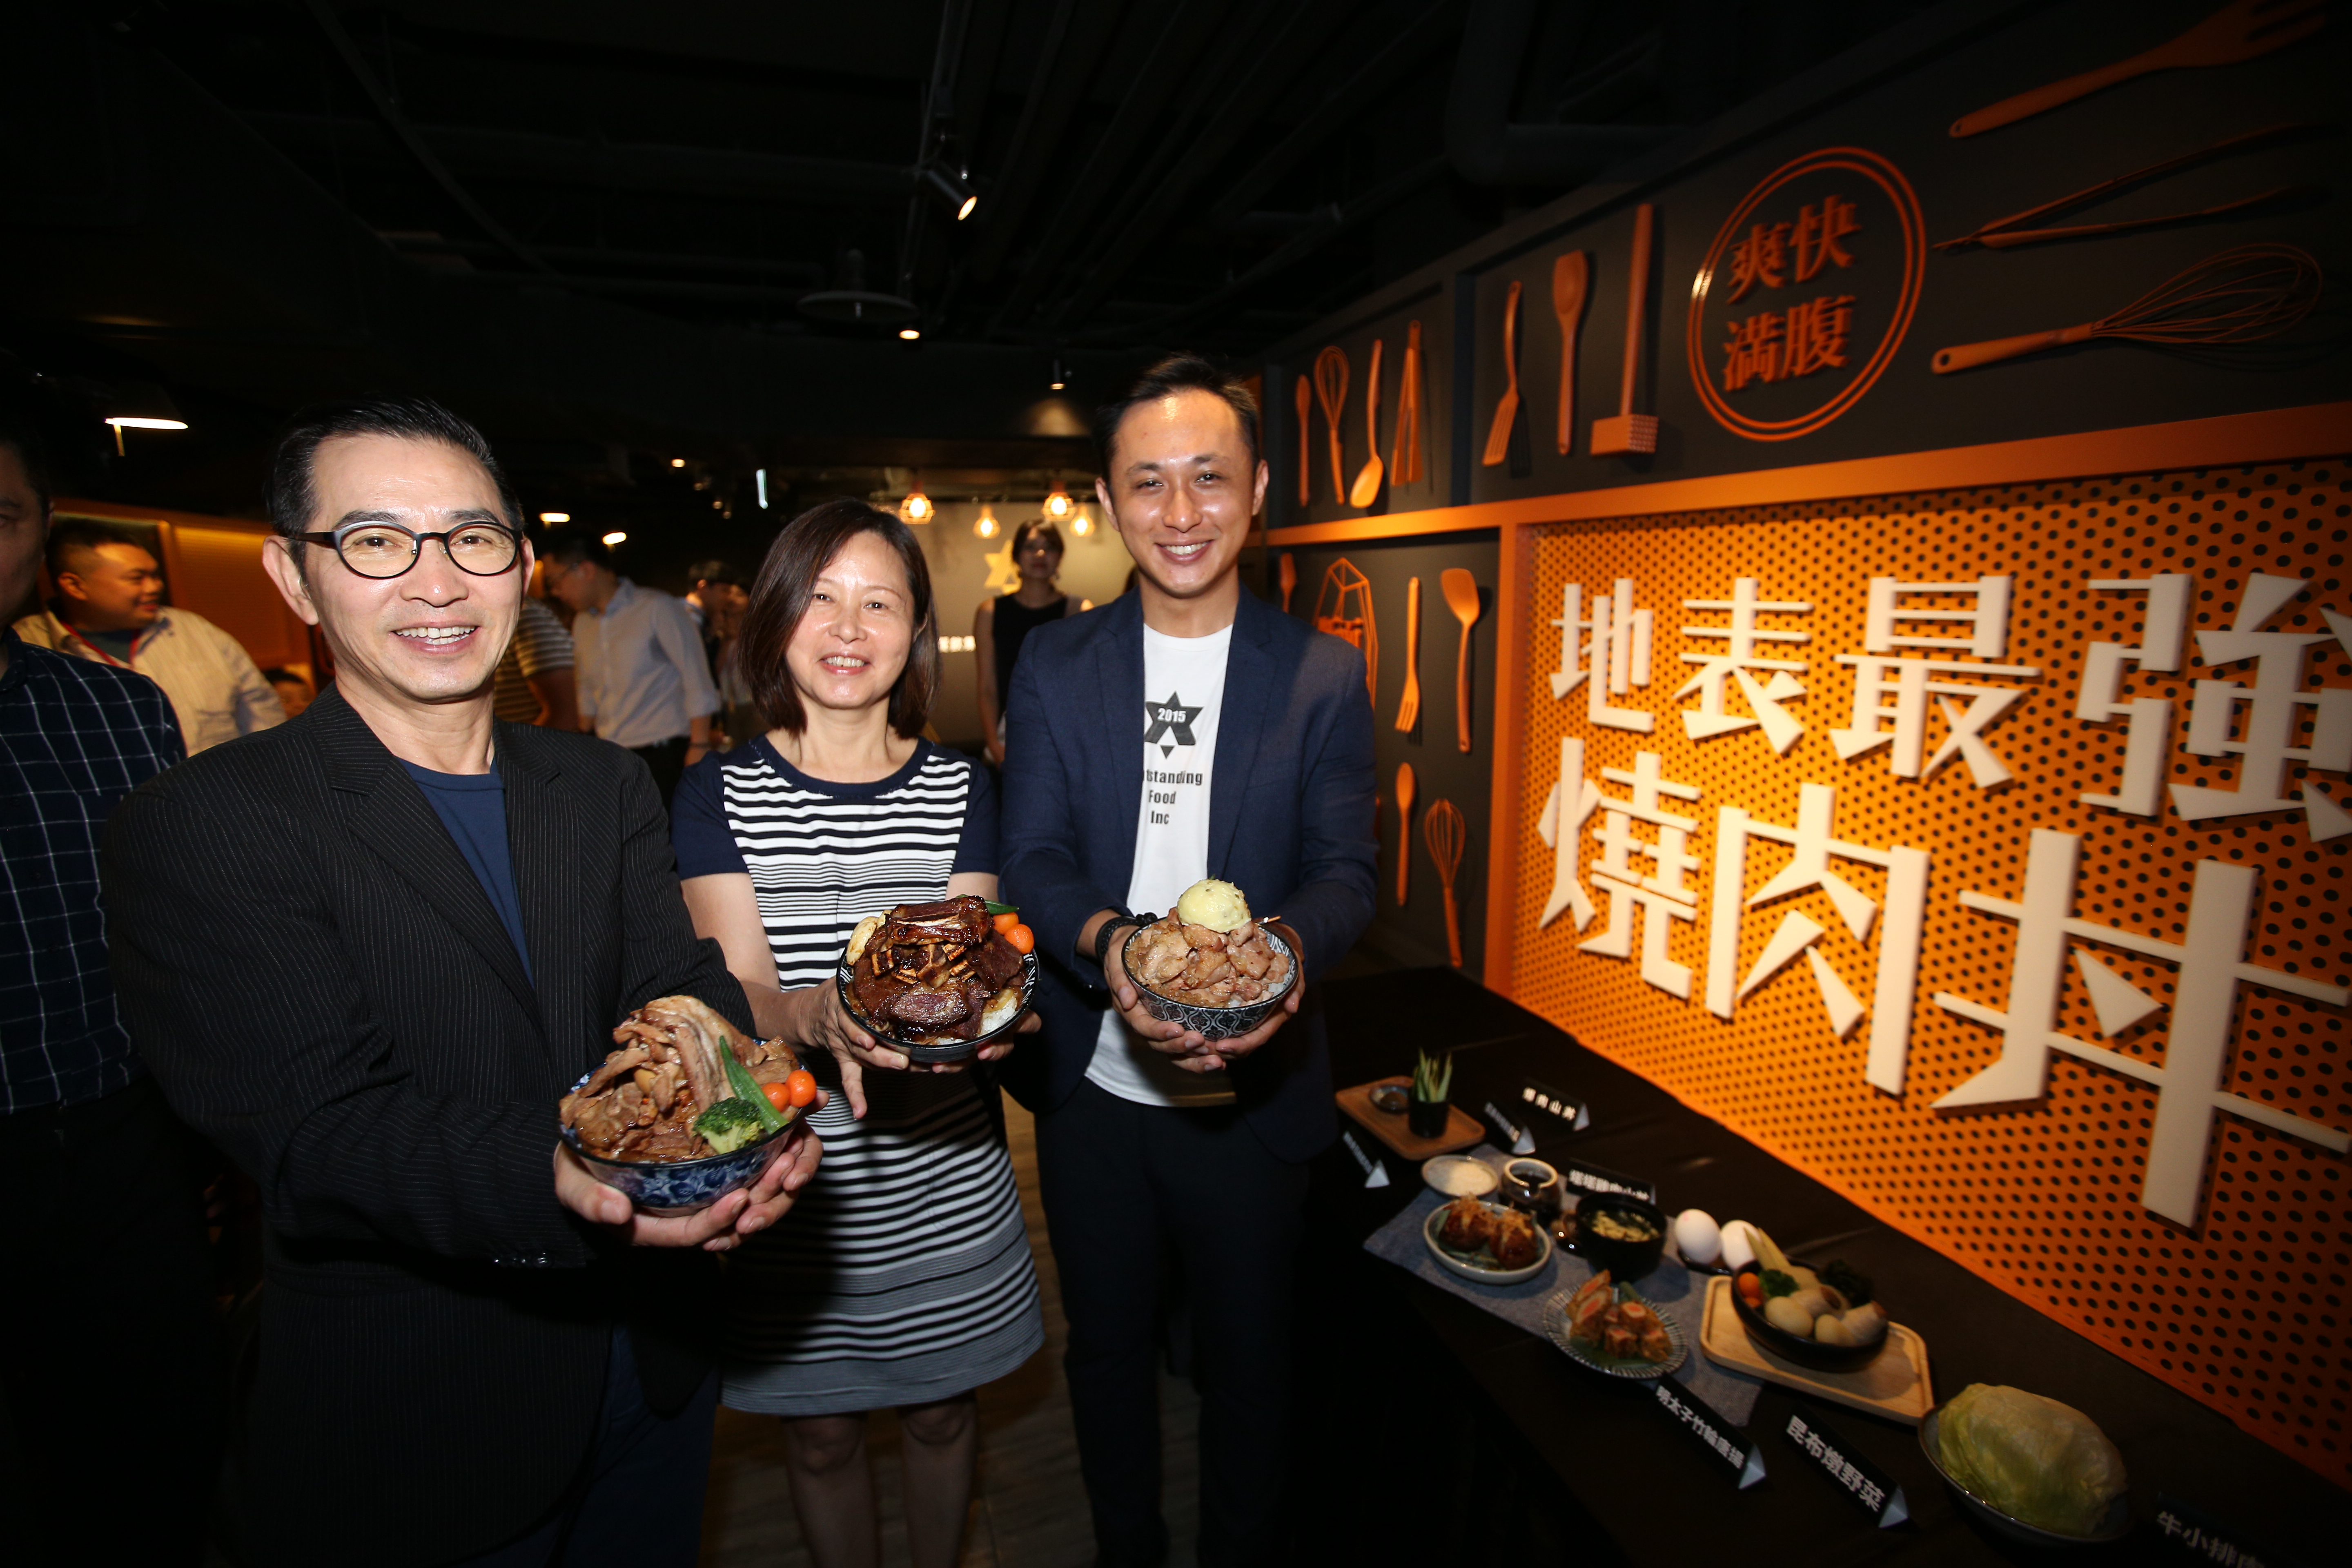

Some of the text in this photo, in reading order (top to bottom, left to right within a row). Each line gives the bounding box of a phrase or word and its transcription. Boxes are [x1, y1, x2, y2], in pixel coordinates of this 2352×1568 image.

[1727, 194, 1862, 305] 爽快
[1157, 708, 1186, 723] 2015
[1549, 572, 2352, 843] 地表最強
[1149, 790, 1176, 804] Food
[1151, 810, 1169, 824] Inc
[1537, 737, 2350, 1227] 燒肉丼
